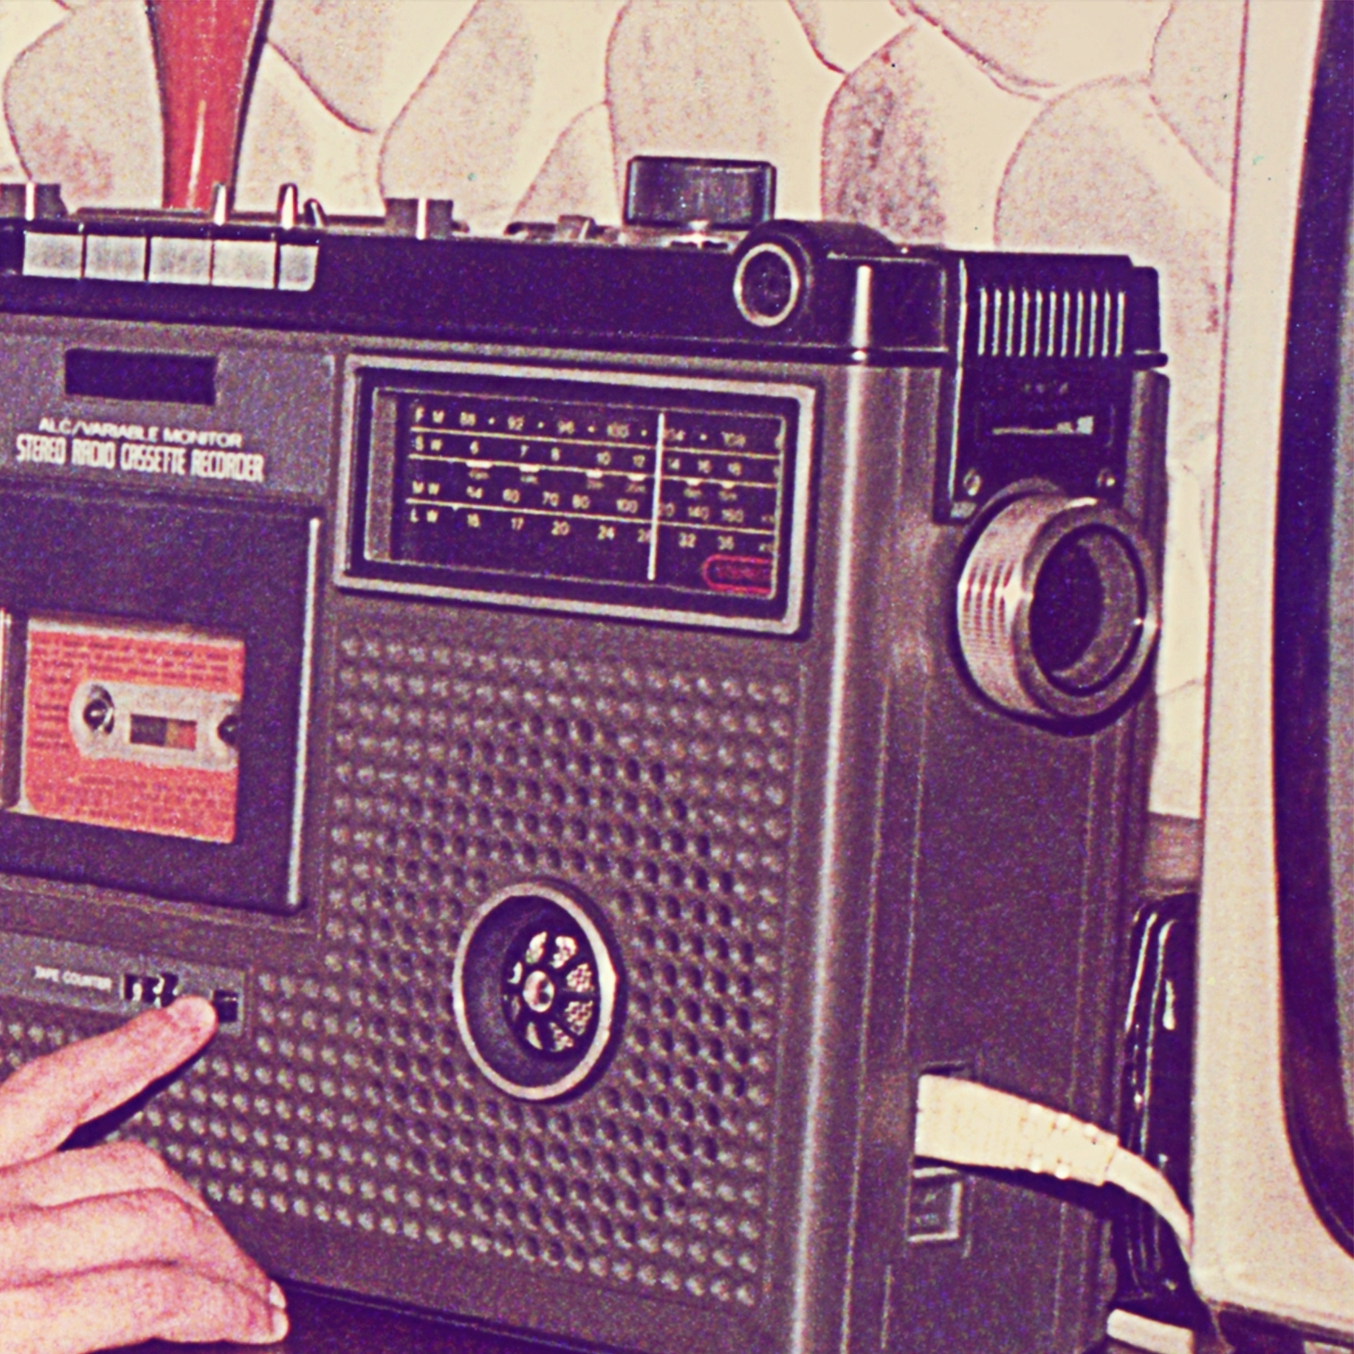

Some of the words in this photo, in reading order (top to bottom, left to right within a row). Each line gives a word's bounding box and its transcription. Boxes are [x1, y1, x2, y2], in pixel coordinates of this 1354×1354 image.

[162, 427, 243, 448] MONITOR
[16, 433, 66, 465] STEREO
[71, 438, 116, 469] RADIO
[120, 442, 186, 475] CASSETTE
[190, 449, 265, 483] RECORDER
